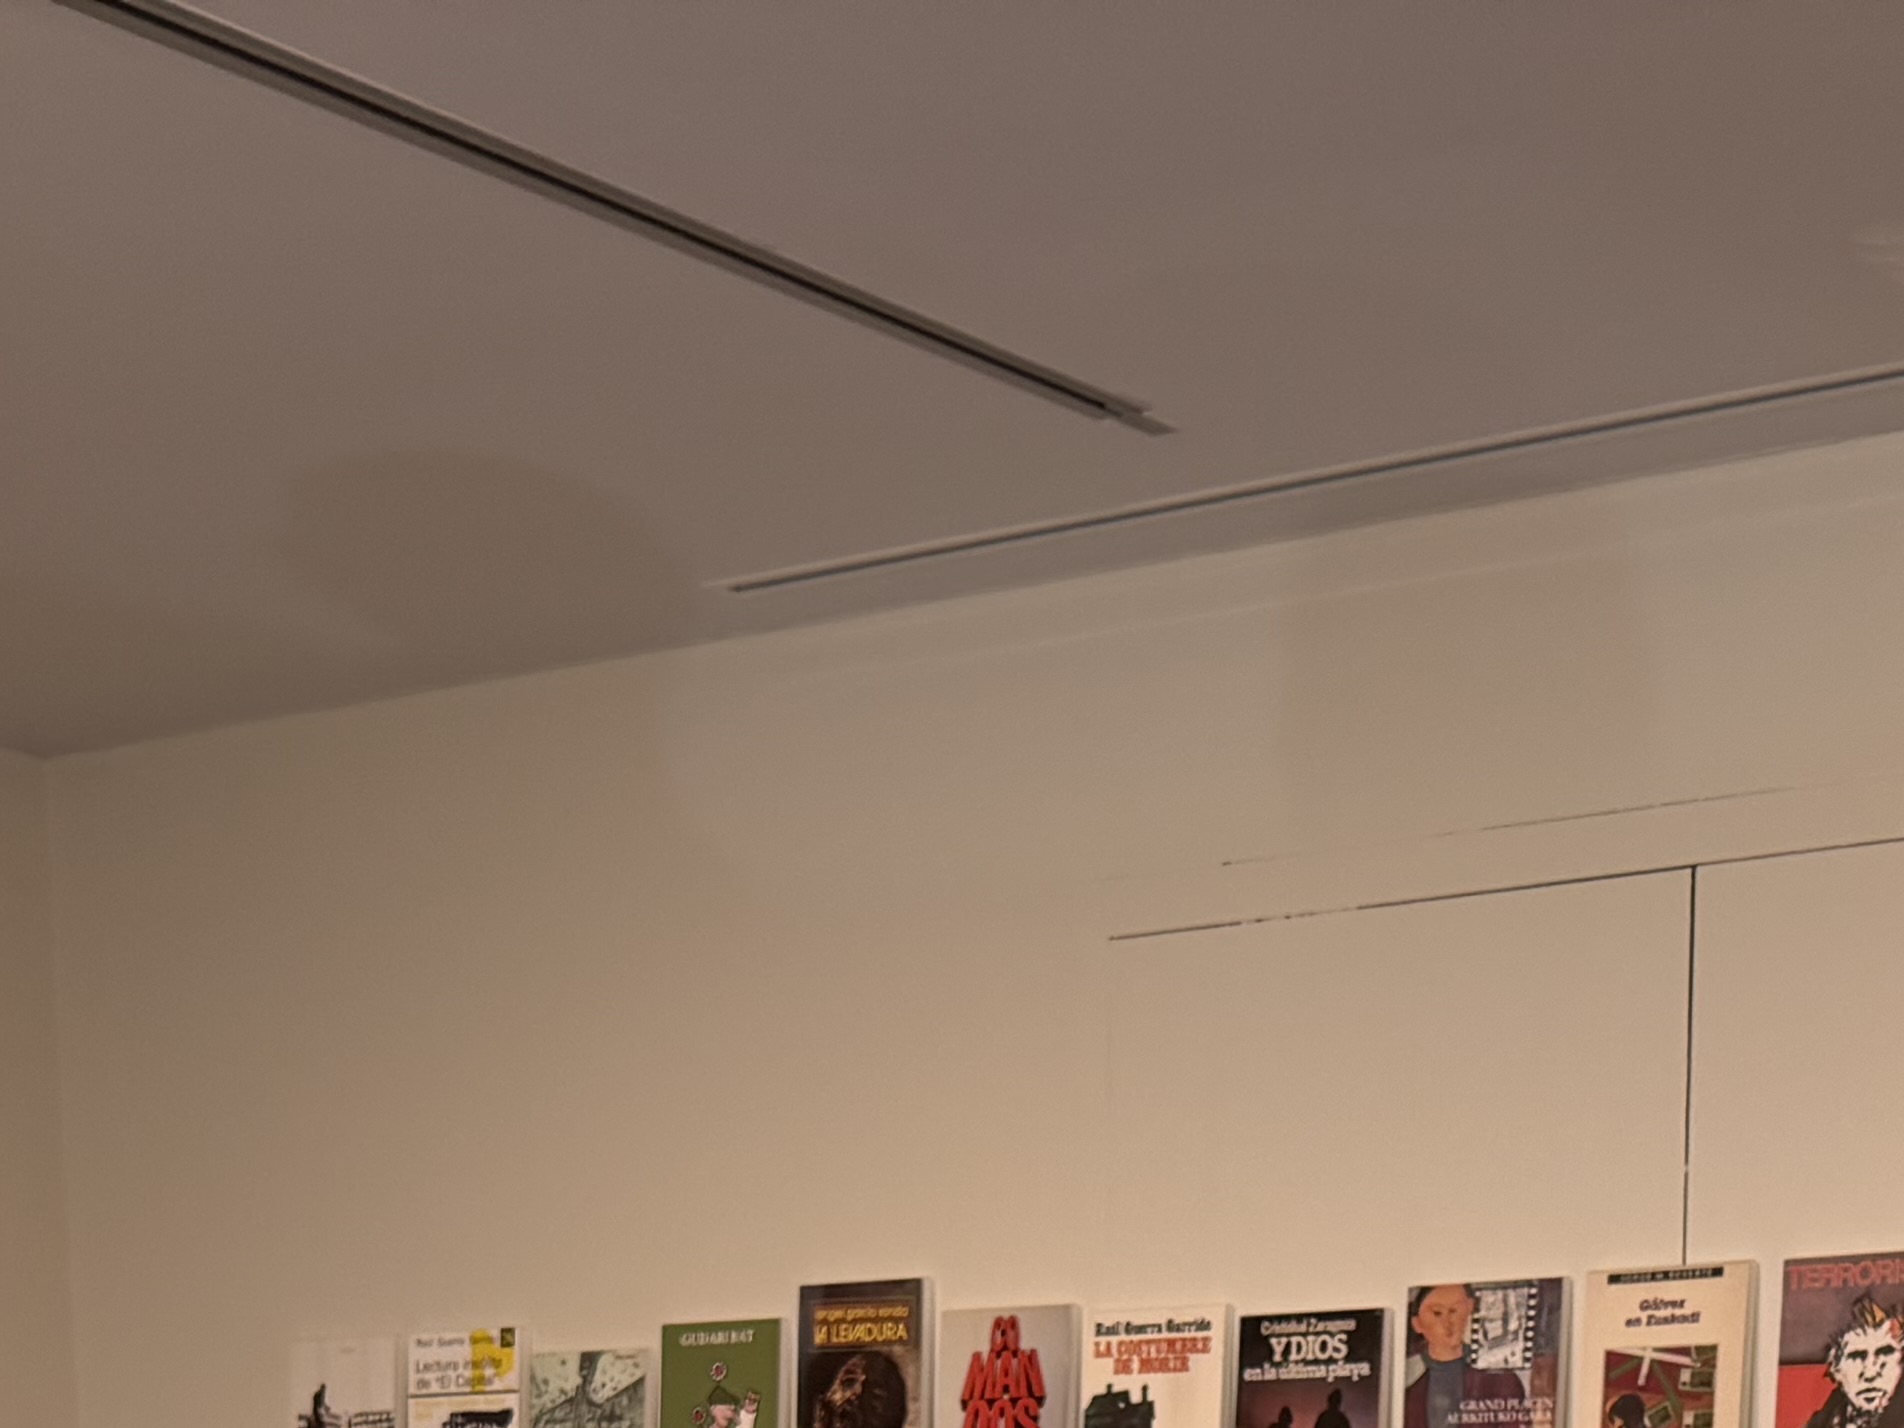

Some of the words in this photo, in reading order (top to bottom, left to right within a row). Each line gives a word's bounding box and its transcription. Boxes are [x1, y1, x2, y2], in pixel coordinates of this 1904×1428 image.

[1124, 1321, 1163, 1335] Guerra
[1166, 1318, 1212, 1333] Garrido
[1094, 1340, 1113, 1359] LA
[1113, 1356, 1134, 1374] DE
[1137, 1355, 1189, 1373] MORIR
